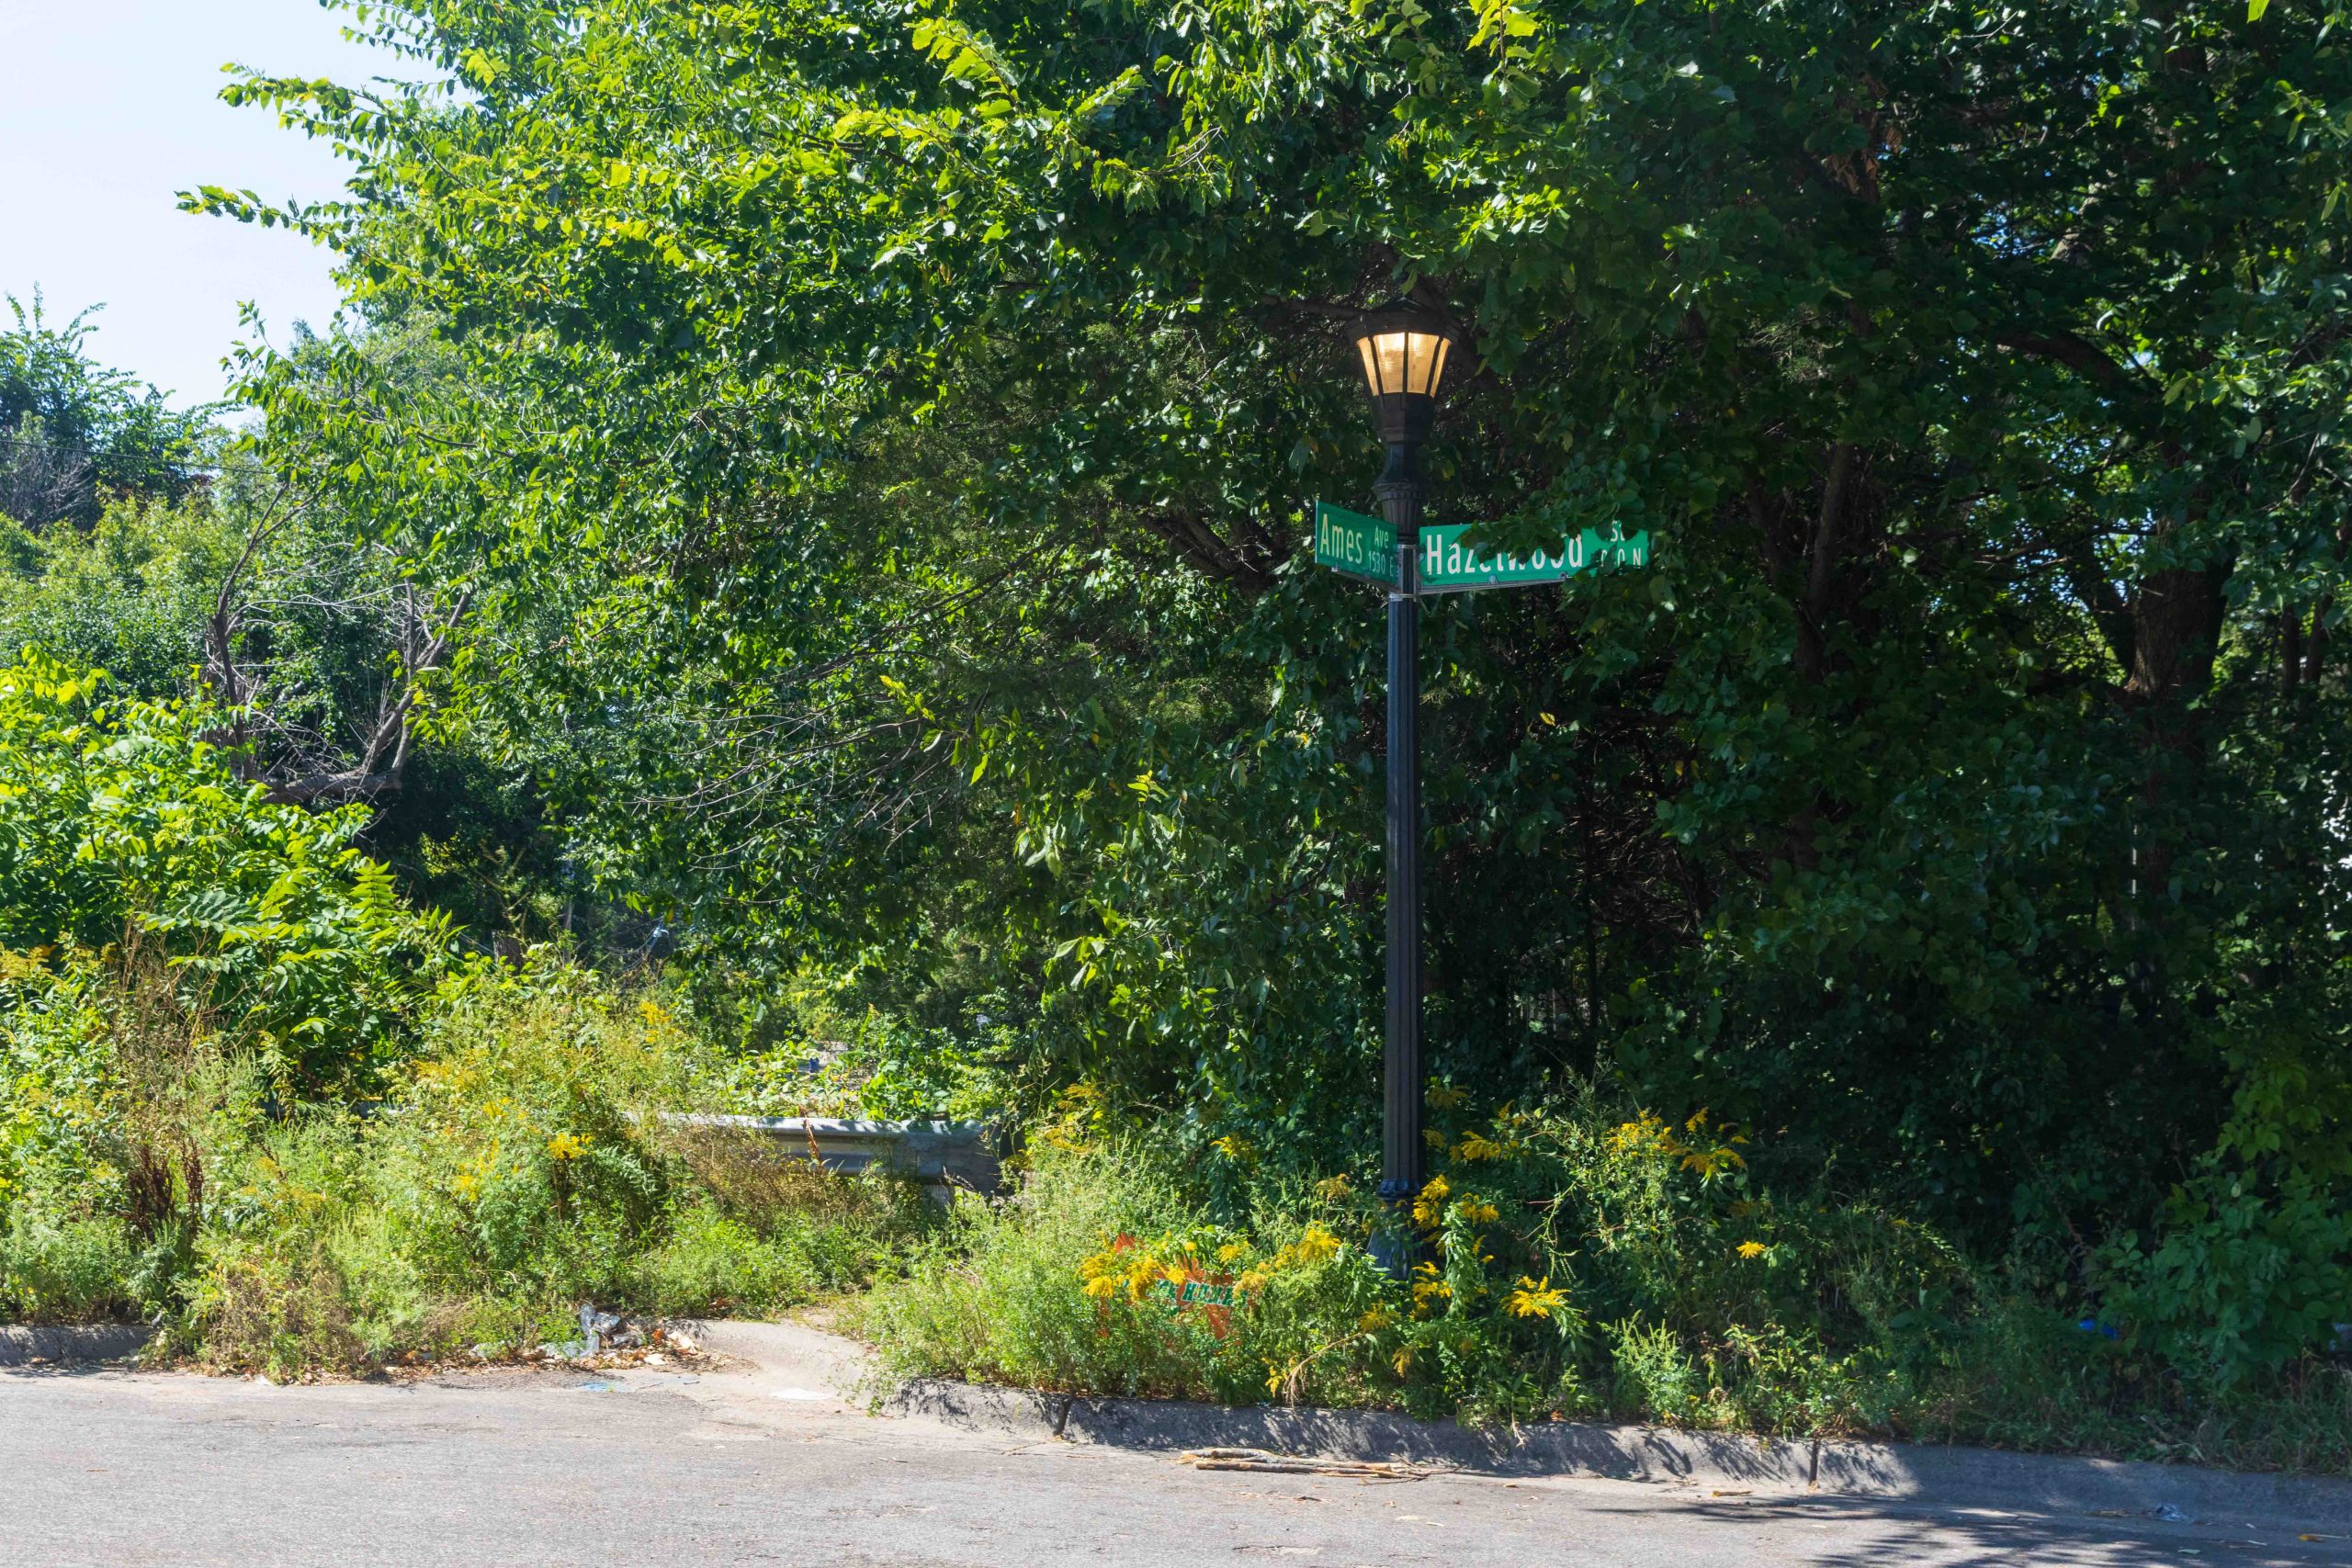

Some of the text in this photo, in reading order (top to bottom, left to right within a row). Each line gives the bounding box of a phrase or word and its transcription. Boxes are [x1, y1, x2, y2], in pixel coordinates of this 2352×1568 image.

[1319, 513, 1389, 564] Ames Ave
[1368, 550, 1386, 574] 1530
[1633, 547, 1642, 569] N
